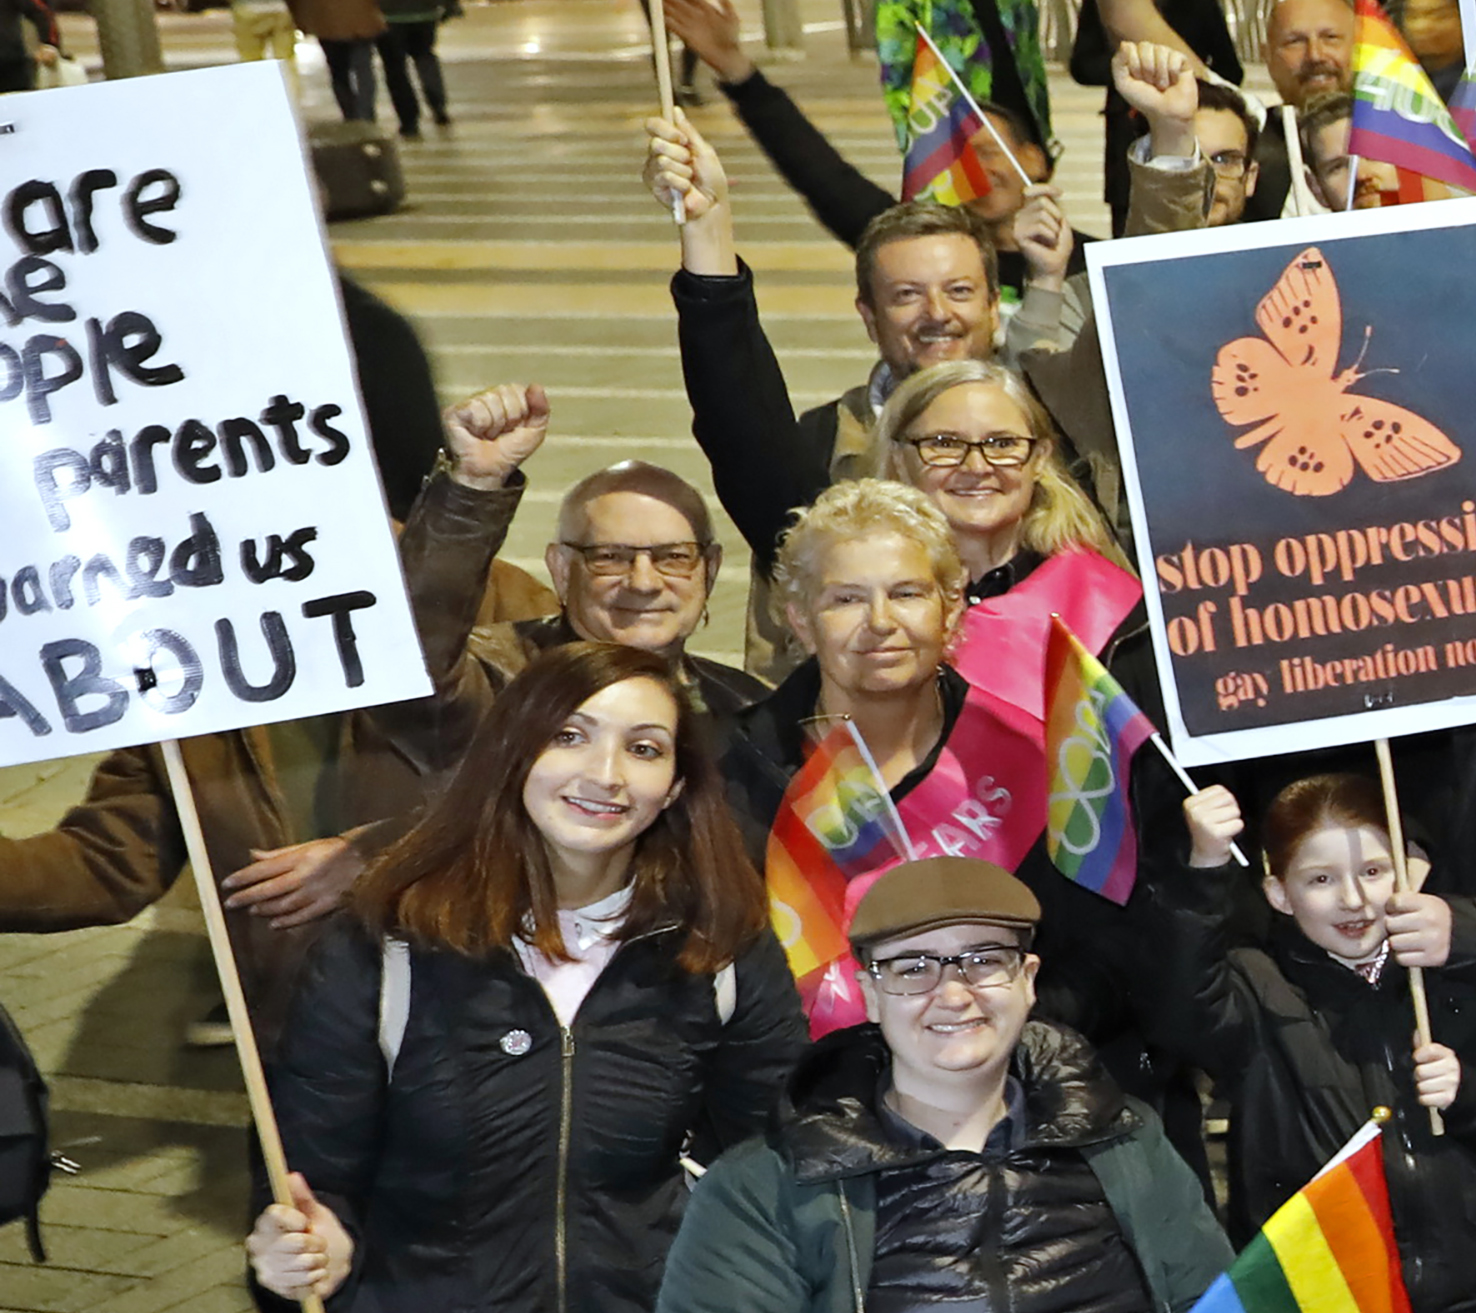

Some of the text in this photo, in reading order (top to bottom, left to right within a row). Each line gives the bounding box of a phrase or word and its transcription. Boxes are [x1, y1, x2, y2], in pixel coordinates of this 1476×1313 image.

[3, 166, 183, 254] are
[33, 393, 350, 533] parents
[240, 525, 318, 585] us
[1156, 539, 1262, 595] stop
[1167, 599, 1217, 657] of
[1214, 671, 1270, 711] gay
[1280, 641, 1438, 694] liberation
